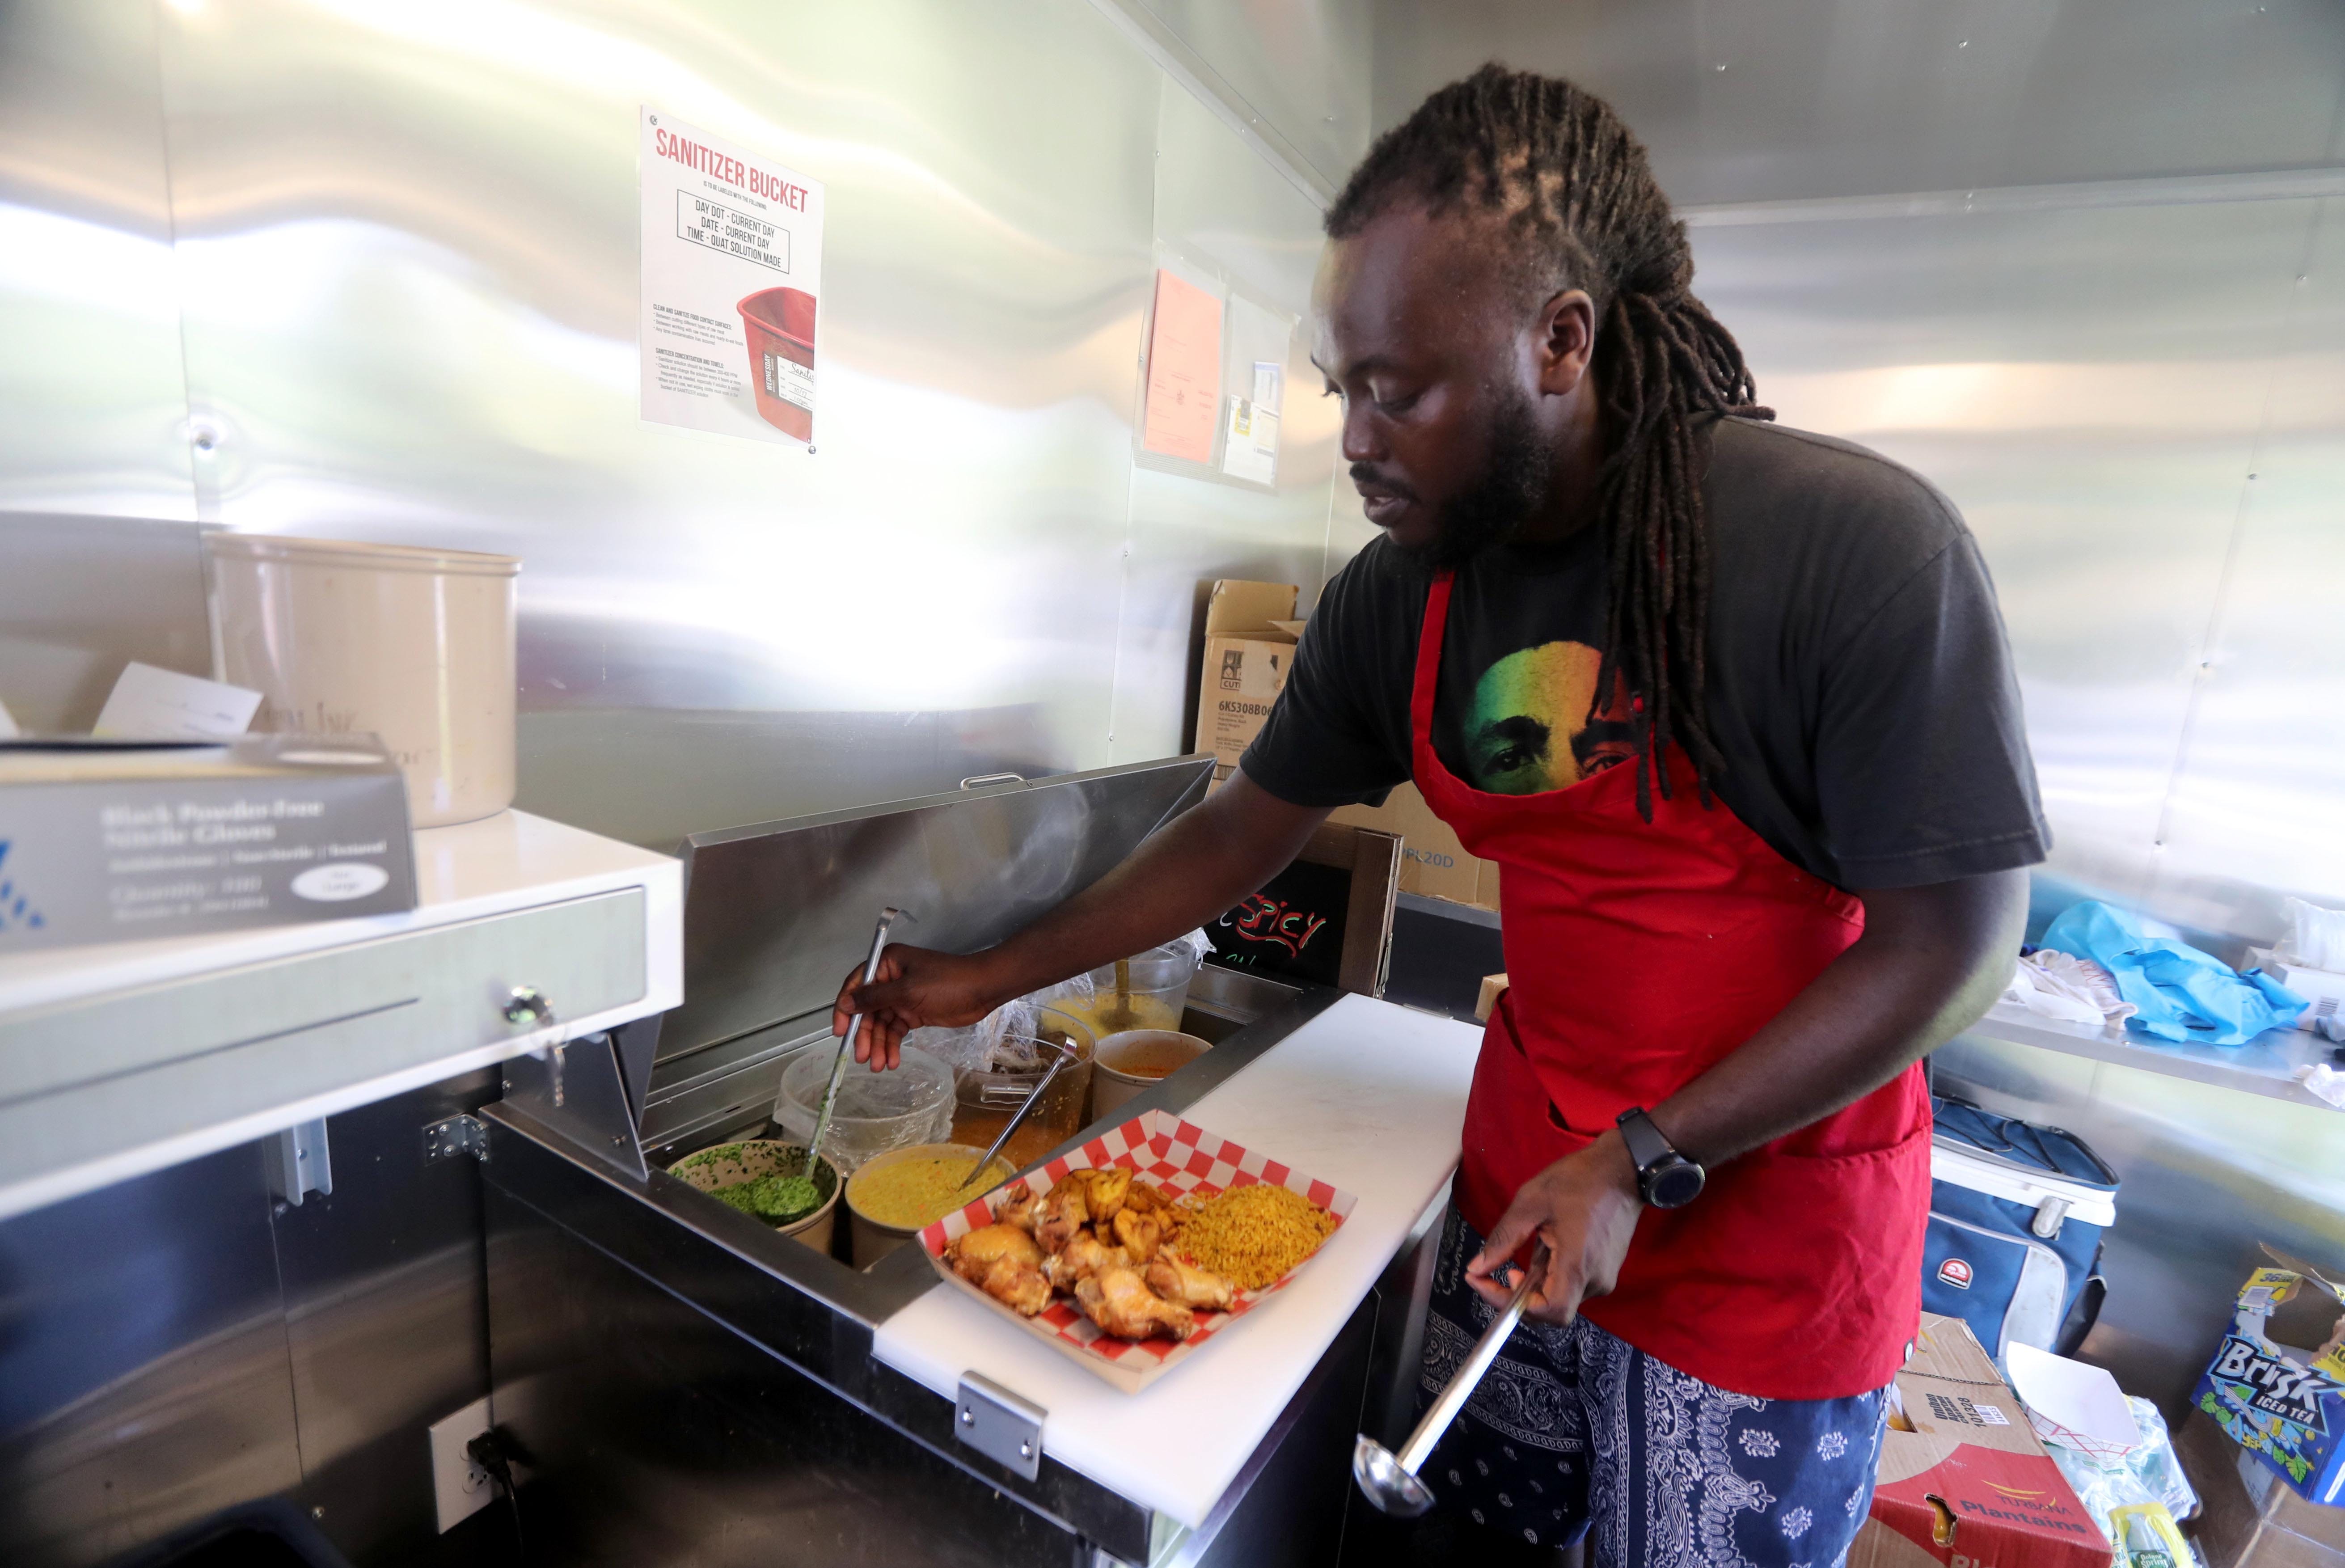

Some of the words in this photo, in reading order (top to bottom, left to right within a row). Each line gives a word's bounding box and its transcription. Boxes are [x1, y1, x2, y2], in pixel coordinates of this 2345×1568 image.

[656, 128, 745, 189] SANITIZER
[750, 167, 807, 213] BUCKET
[718, 186, 733, 196] LABELED
[696, 199, 710, 214] DAY
[711, 206, 725, 220] DOT
[731, 213, 761, 233] CURRENT
[763, 225, 774, 238] DAY
[701, 216, 718, 232] DATE
[726, 225, 756, 245] CURRENT
[757, 237, 769, 249] DAY
[687, 226, 704, 242] TIME
[711, 235, 729, 249] QUAT
[731, 241, 762, 261] SOLUTION
[763, 253, 781, 267] MADE
[653, 304, 665, 312] CLEAN
[674, 309, 689, 319] SANITIZE
[700, 317, 714, 325] CONTACT
[656, 347, 674, 357] SANITIZER
[675, 352, 702, 363] CONCENTRATION
[764, 353, 773, 391] WEDNESDAY
[1224, 680, 1240, 689] CUT
[2260, 1272, 2282, 1282] 36
[1957, 1397, 1987, 1428] 101328
[2256, 1395, 2288, 1413] ICED
[2289, 1407, 2315, 1424] TEA
[1960, 1500, 2087, 1534] Plantains
[1996, 1495, 2074, 1517] TURBANA
